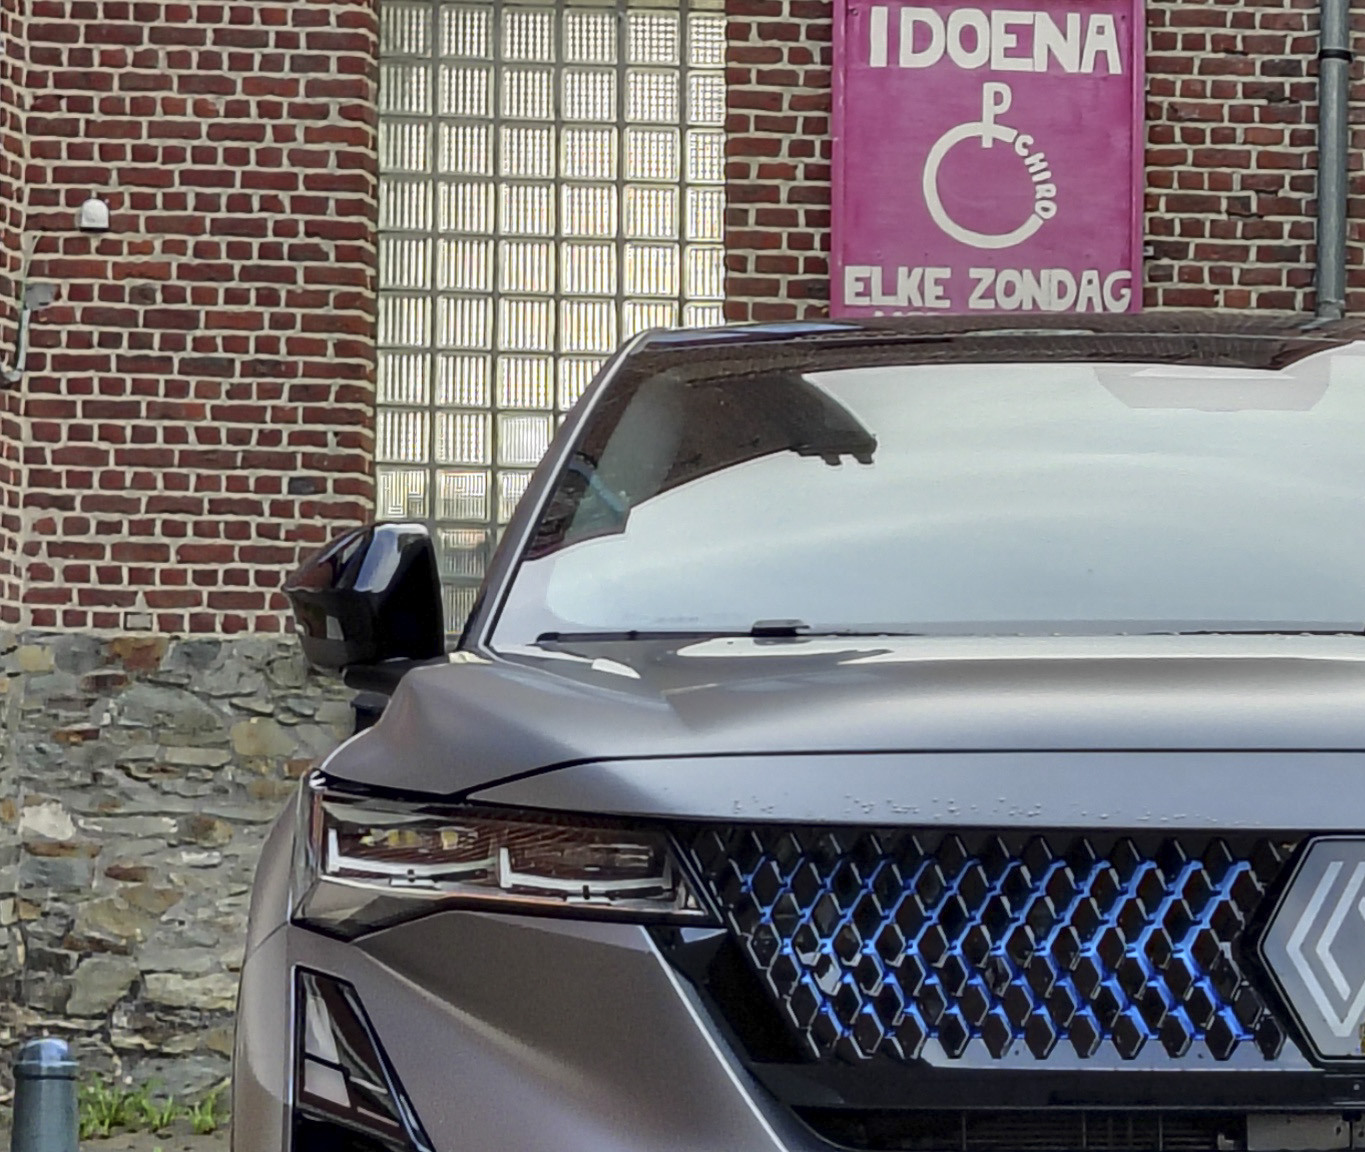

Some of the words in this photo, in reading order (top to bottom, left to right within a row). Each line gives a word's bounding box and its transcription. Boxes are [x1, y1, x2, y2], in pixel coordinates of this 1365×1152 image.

[1014, 134, 1058, 220] CHIRO
[844, 265, 951, 308] ELKE
[968, 267, 1132, 313] ZONDAG
